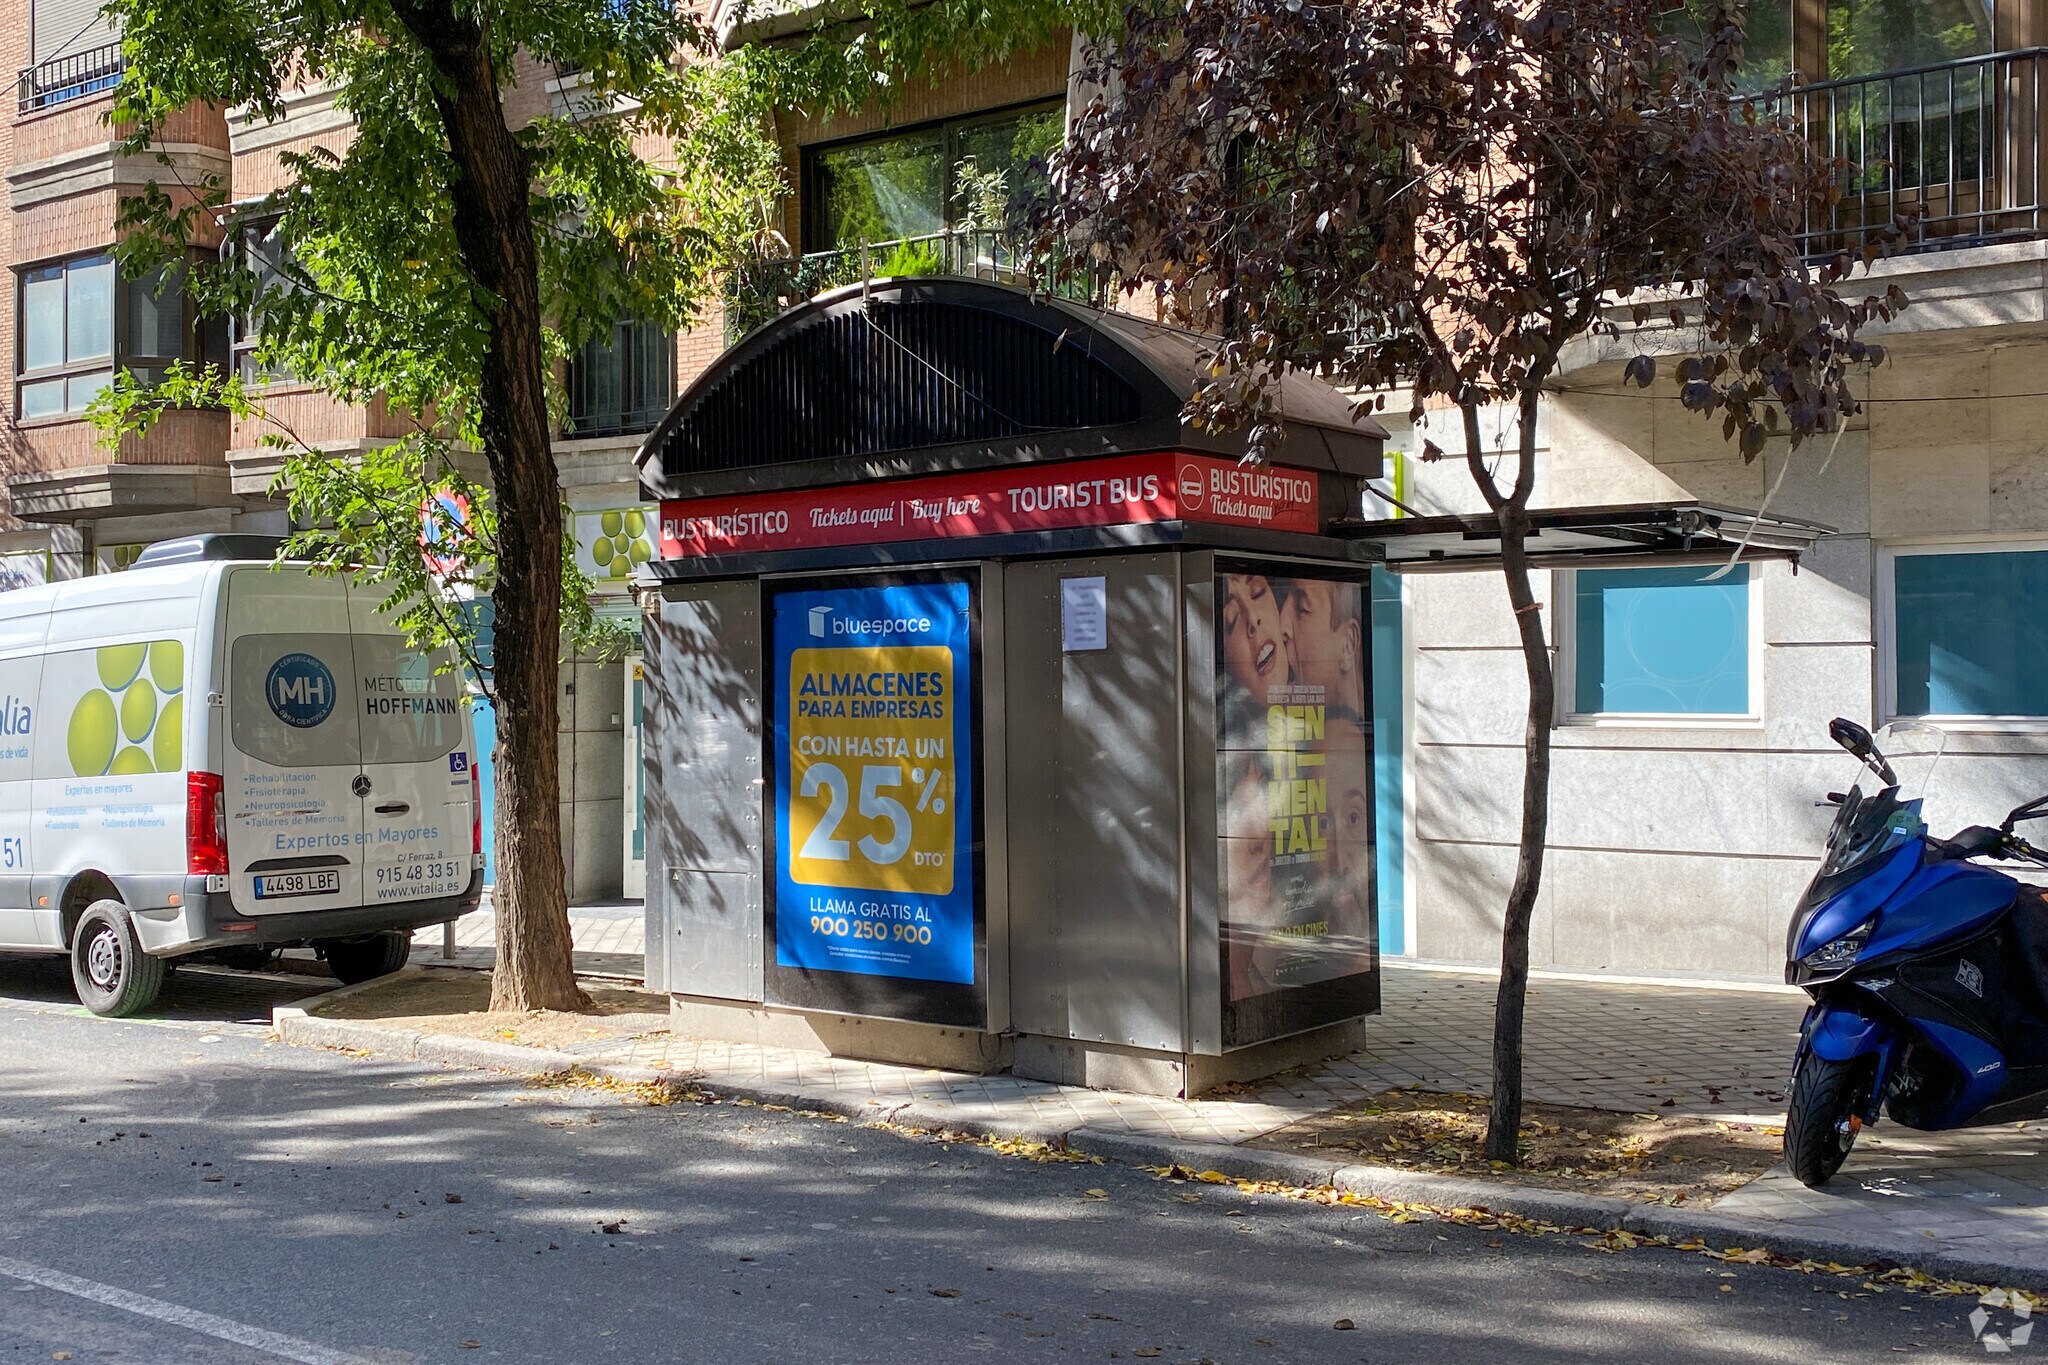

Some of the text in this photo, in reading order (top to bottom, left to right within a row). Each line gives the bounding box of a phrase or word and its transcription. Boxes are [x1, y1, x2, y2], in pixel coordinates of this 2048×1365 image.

[1007, 474, 1159, 513] TOURIST BUS
[1210, 468, 1312, 504] BUS TURÍSTICO
[809, 497, 980, 528] Tickets aquí Buy here
[1210, 494, 1246, 518] Tickets
[1249, 501, 1273, 525] aquí
[663, 508, 789, 541] BUS TURÍSTICO
[832, 617, 931, 637] bluespace
[279, 656, 320, 668] CERTIFICADO
[278, 676, 325, 705] MH
[364, 673, 424, 692] MÉTODO
[799, 672, 944, 697] ALMACENES
[0, 695, 31, 736] lia
[279, 709, 296, 724] OBRA
[366, 698, 457, 715] HOFFMANN
[798, 700, 944, 719] PARA EMPRESAS
[1267, 705, 1325, 742] SEN
[5, 748, 14, 759] de
[14, 747, 29, 758] vida
[798, 735, 944, 759] CON HASTA UN
[65, 784, 133, 797] Expertos en mayores
[1268, 778, 1327, 817] MEN
[251, 818, 289, 828] Talleres
[292, 817, 303, 826] de
[275, 827, 438, 852] Expertos en Mayores
[1269, 816, 1327, 855] TAL
[4, 838, 23, 868] 51
[397, 853, 407, 862] C/
[437, 850, 443, 859] 8
[266, 876, 304, 892] 4498
[308, 873, 335, 890] LBF
[376, 861, 459, 884] 915 48 33 51
[377, 880, 459, 898] www.vitalia.es
[810, 897, 932, 922] LLAMA GRATIS AL
[810, 915, 932, 945] 900 250 900
[1305, 920, 1329, 937] CINES
